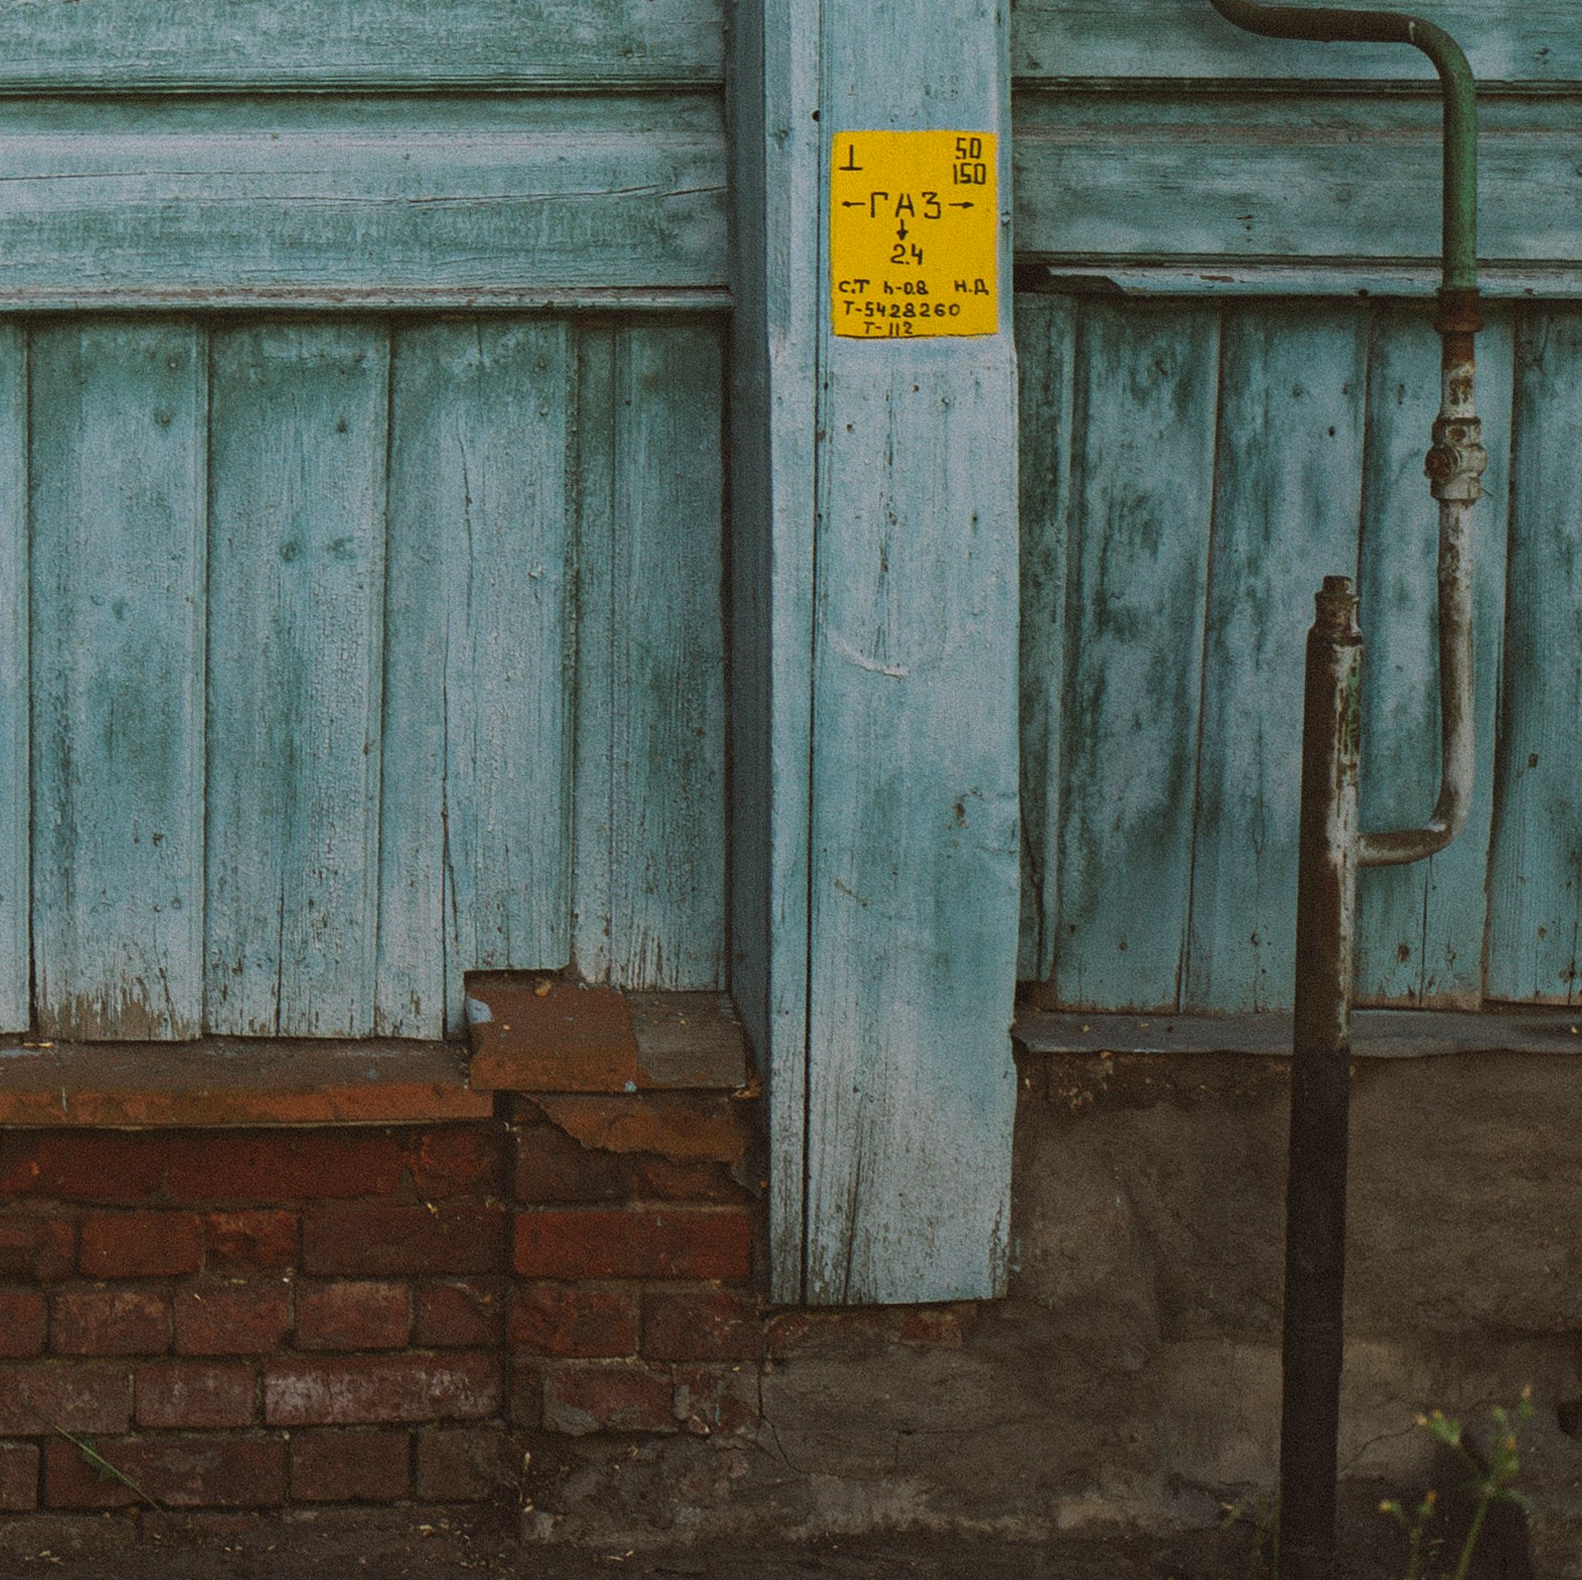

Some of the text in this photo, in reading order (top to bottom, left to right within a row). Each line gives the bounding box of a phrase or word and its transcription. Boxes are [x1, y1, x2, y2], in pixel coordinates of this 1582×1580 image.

[956, 137, 982, 159] 50
[953, 163, 986, 185] 150
[871, 192, 941, 219] ГАЗ
[890, 244, 923, 265] 2.4
